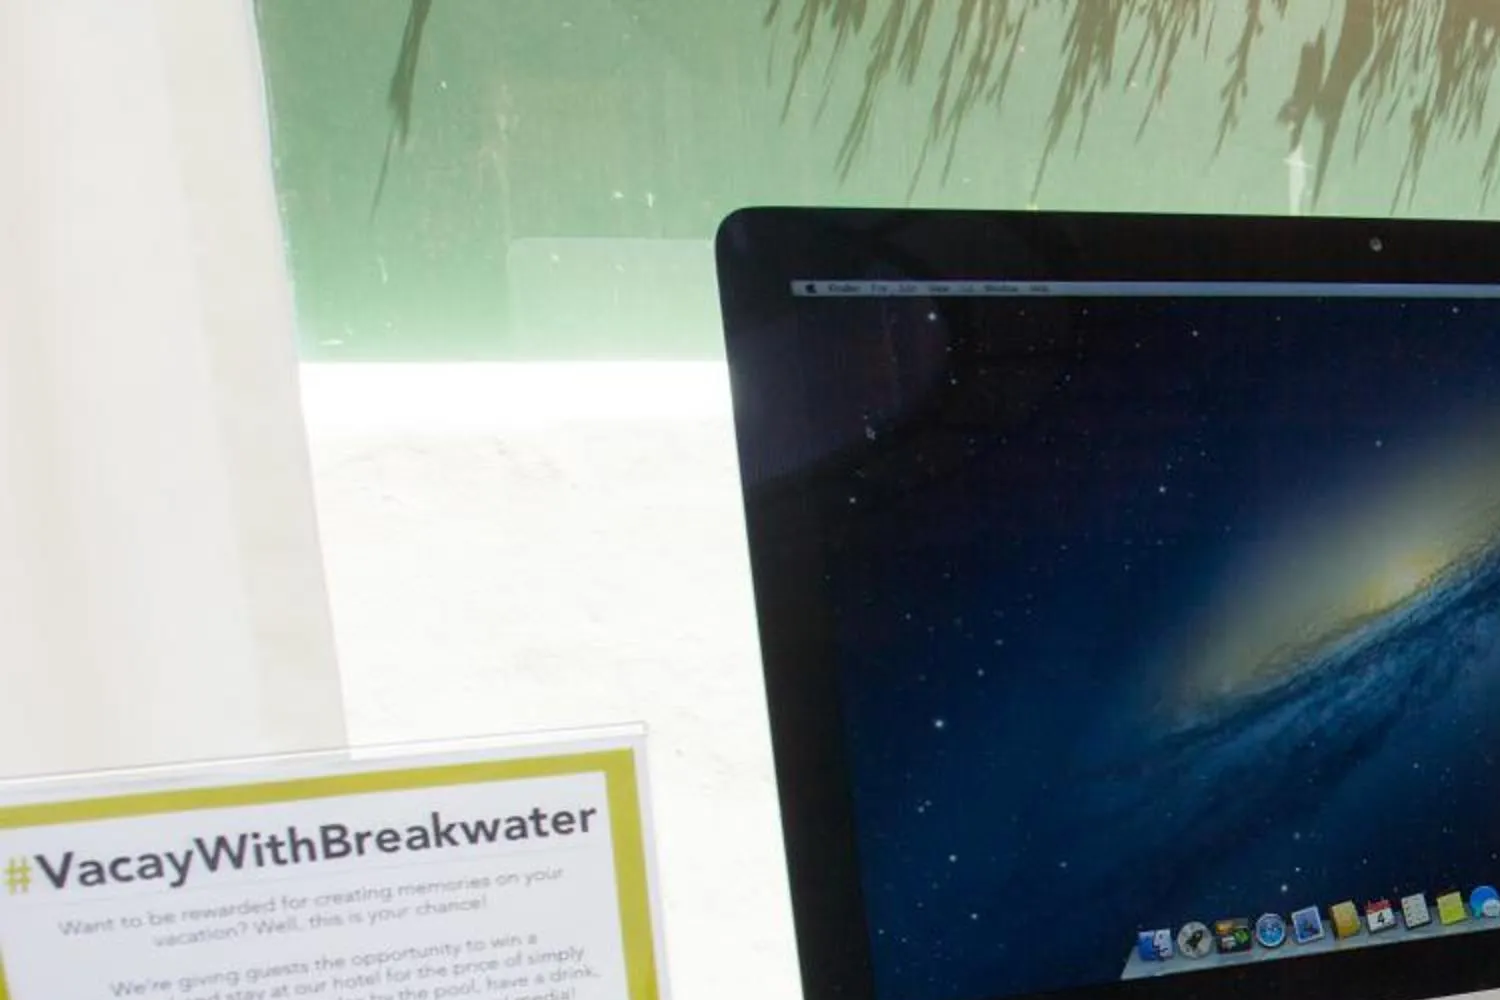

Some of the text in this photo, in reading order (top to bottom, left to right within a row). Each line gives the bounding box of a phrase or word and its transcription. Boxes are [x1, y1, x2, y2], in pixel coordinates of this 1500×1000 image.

[5, 807, 597, 895] #VacayWithBreakwater
[58, 867, 564, 937] Want to be rewarded for creating memories on your
[153, 922, 247, 947] vacation?
[309, 911, 344, 929] this
[348, 908, 364, 924] is
[368, 905, 407, 926] your
[416, 895, 487, 916] chance!
[110, 933, 538, 998] We're giving guests the opportunity to win a
[270, 983, 288, 999] at
[294, 980, 327, 997] our
[333, 968, 381, 989] hotel
[386, 966, 412, 983] for
[417, 961, 447, 978] the
[452, 957, 498, 976] price
[503, 950, 524, 968] of
[527, 945, 585, 967] simply
[486, 974, 528, 993] have
[534, 973, 545, 987] a
